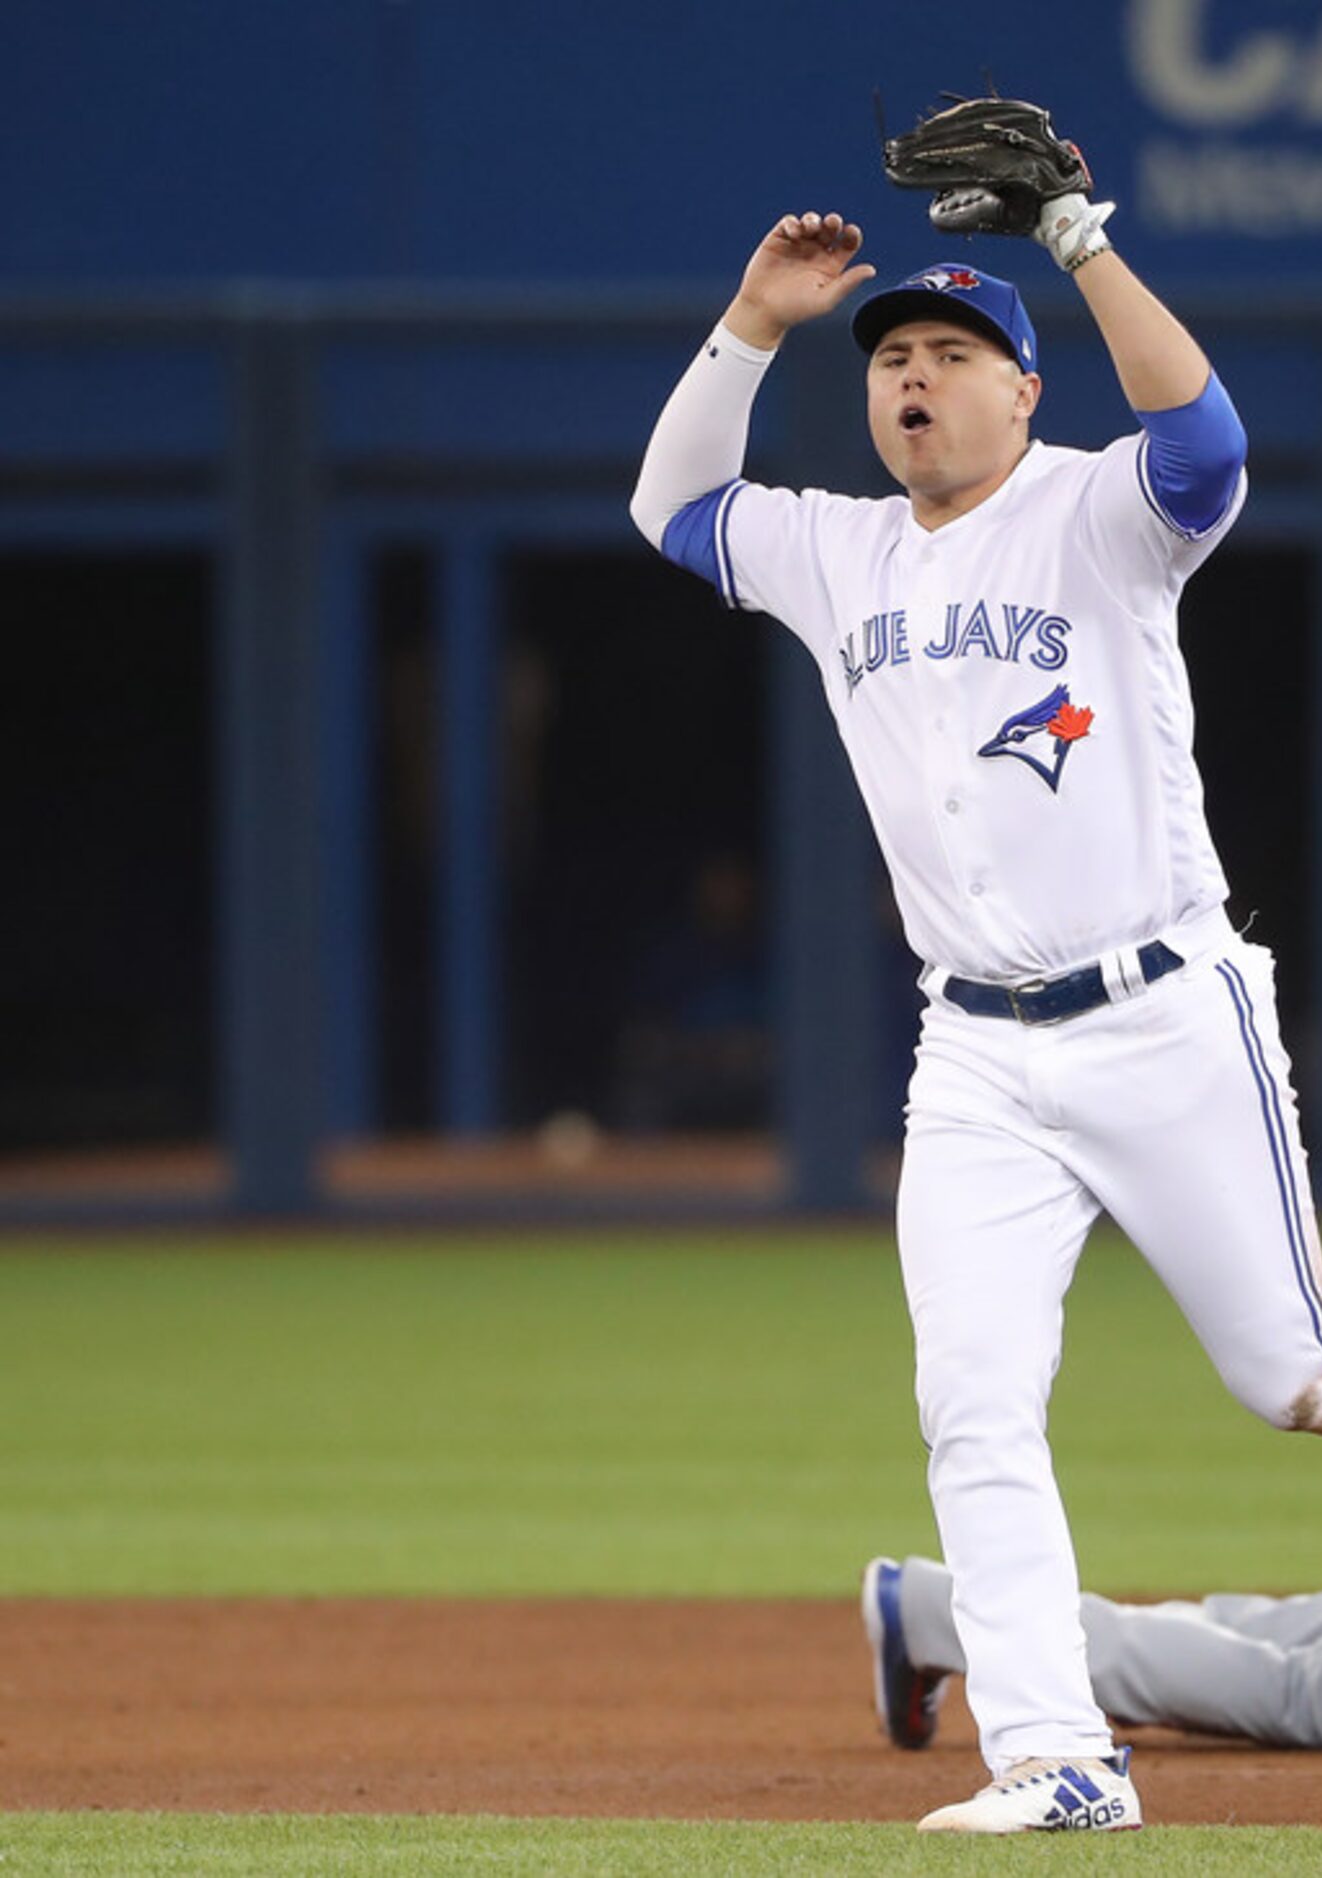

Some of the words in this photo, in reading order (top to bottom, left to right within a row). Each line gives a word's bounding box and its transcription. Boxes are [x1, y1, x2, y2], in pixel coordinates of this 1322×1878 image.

[840, 609, 911, 697] LUE
[923, 599, 1073, 671] JAYS
[1050, 1797, 1125, 1832] didas
